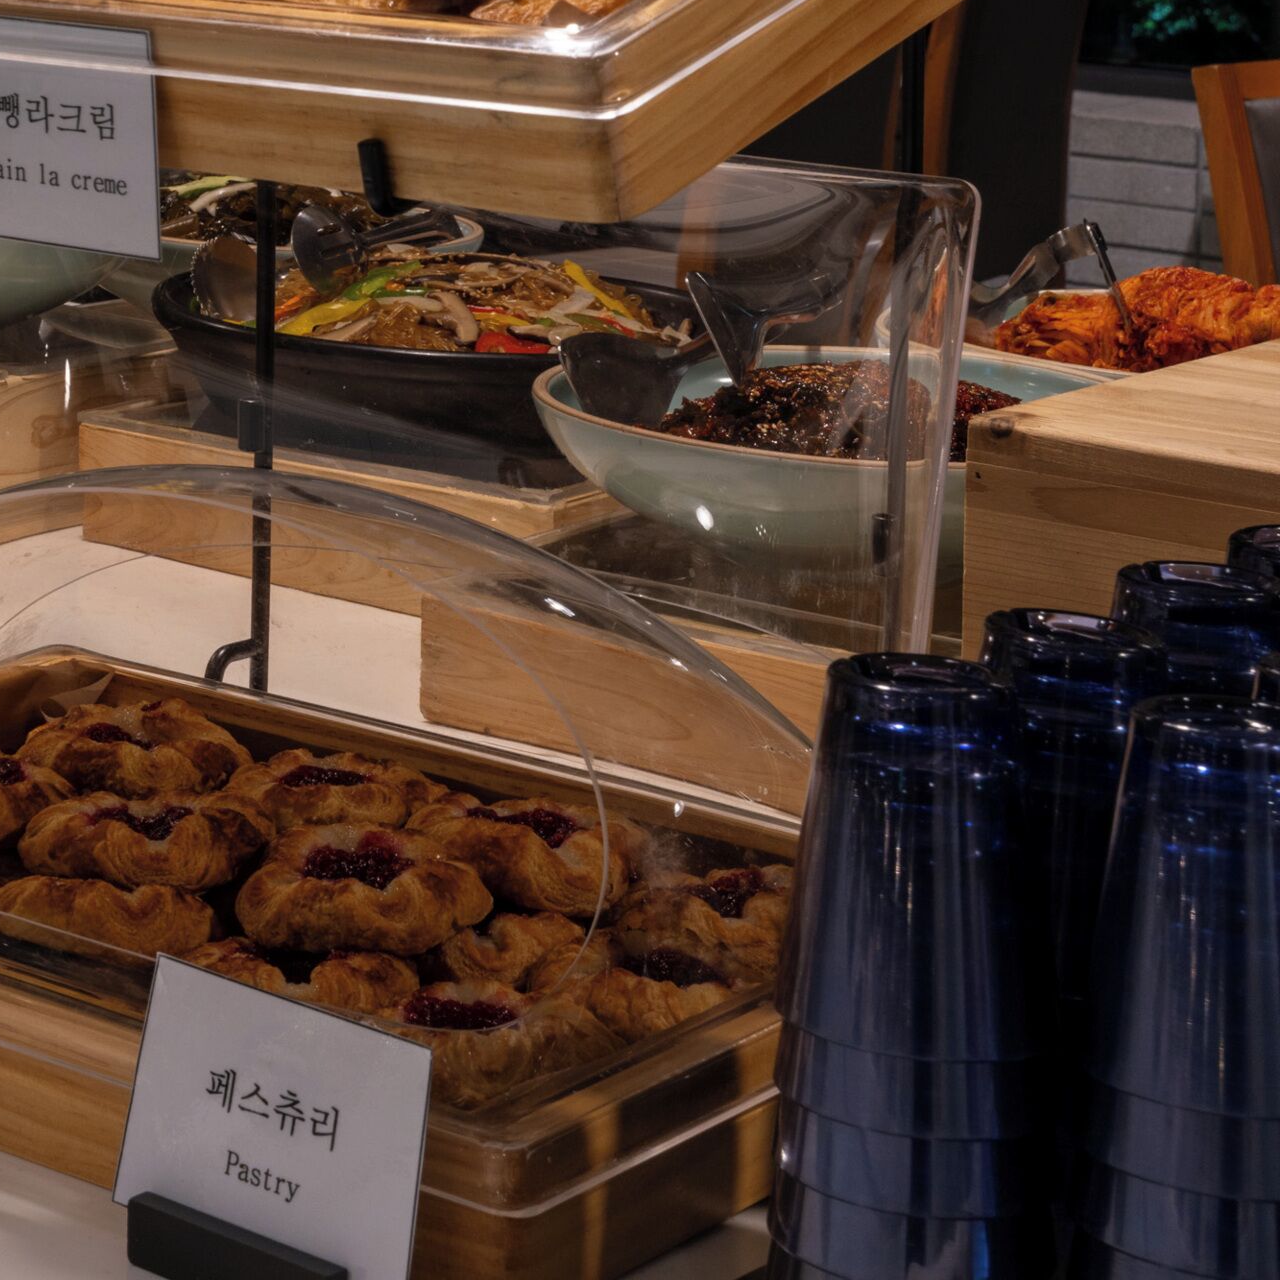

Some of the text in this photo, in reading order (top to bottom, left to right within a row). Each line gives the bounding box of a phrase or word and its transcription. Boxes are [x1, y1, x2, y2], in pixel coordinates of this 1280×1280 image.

[39, 163, 60, 187] la
[71, 173, 128, 196] creme
[206, 1068, 340, 1152] 페스츄리
[224, 1150, 301, 1204] Pastry
